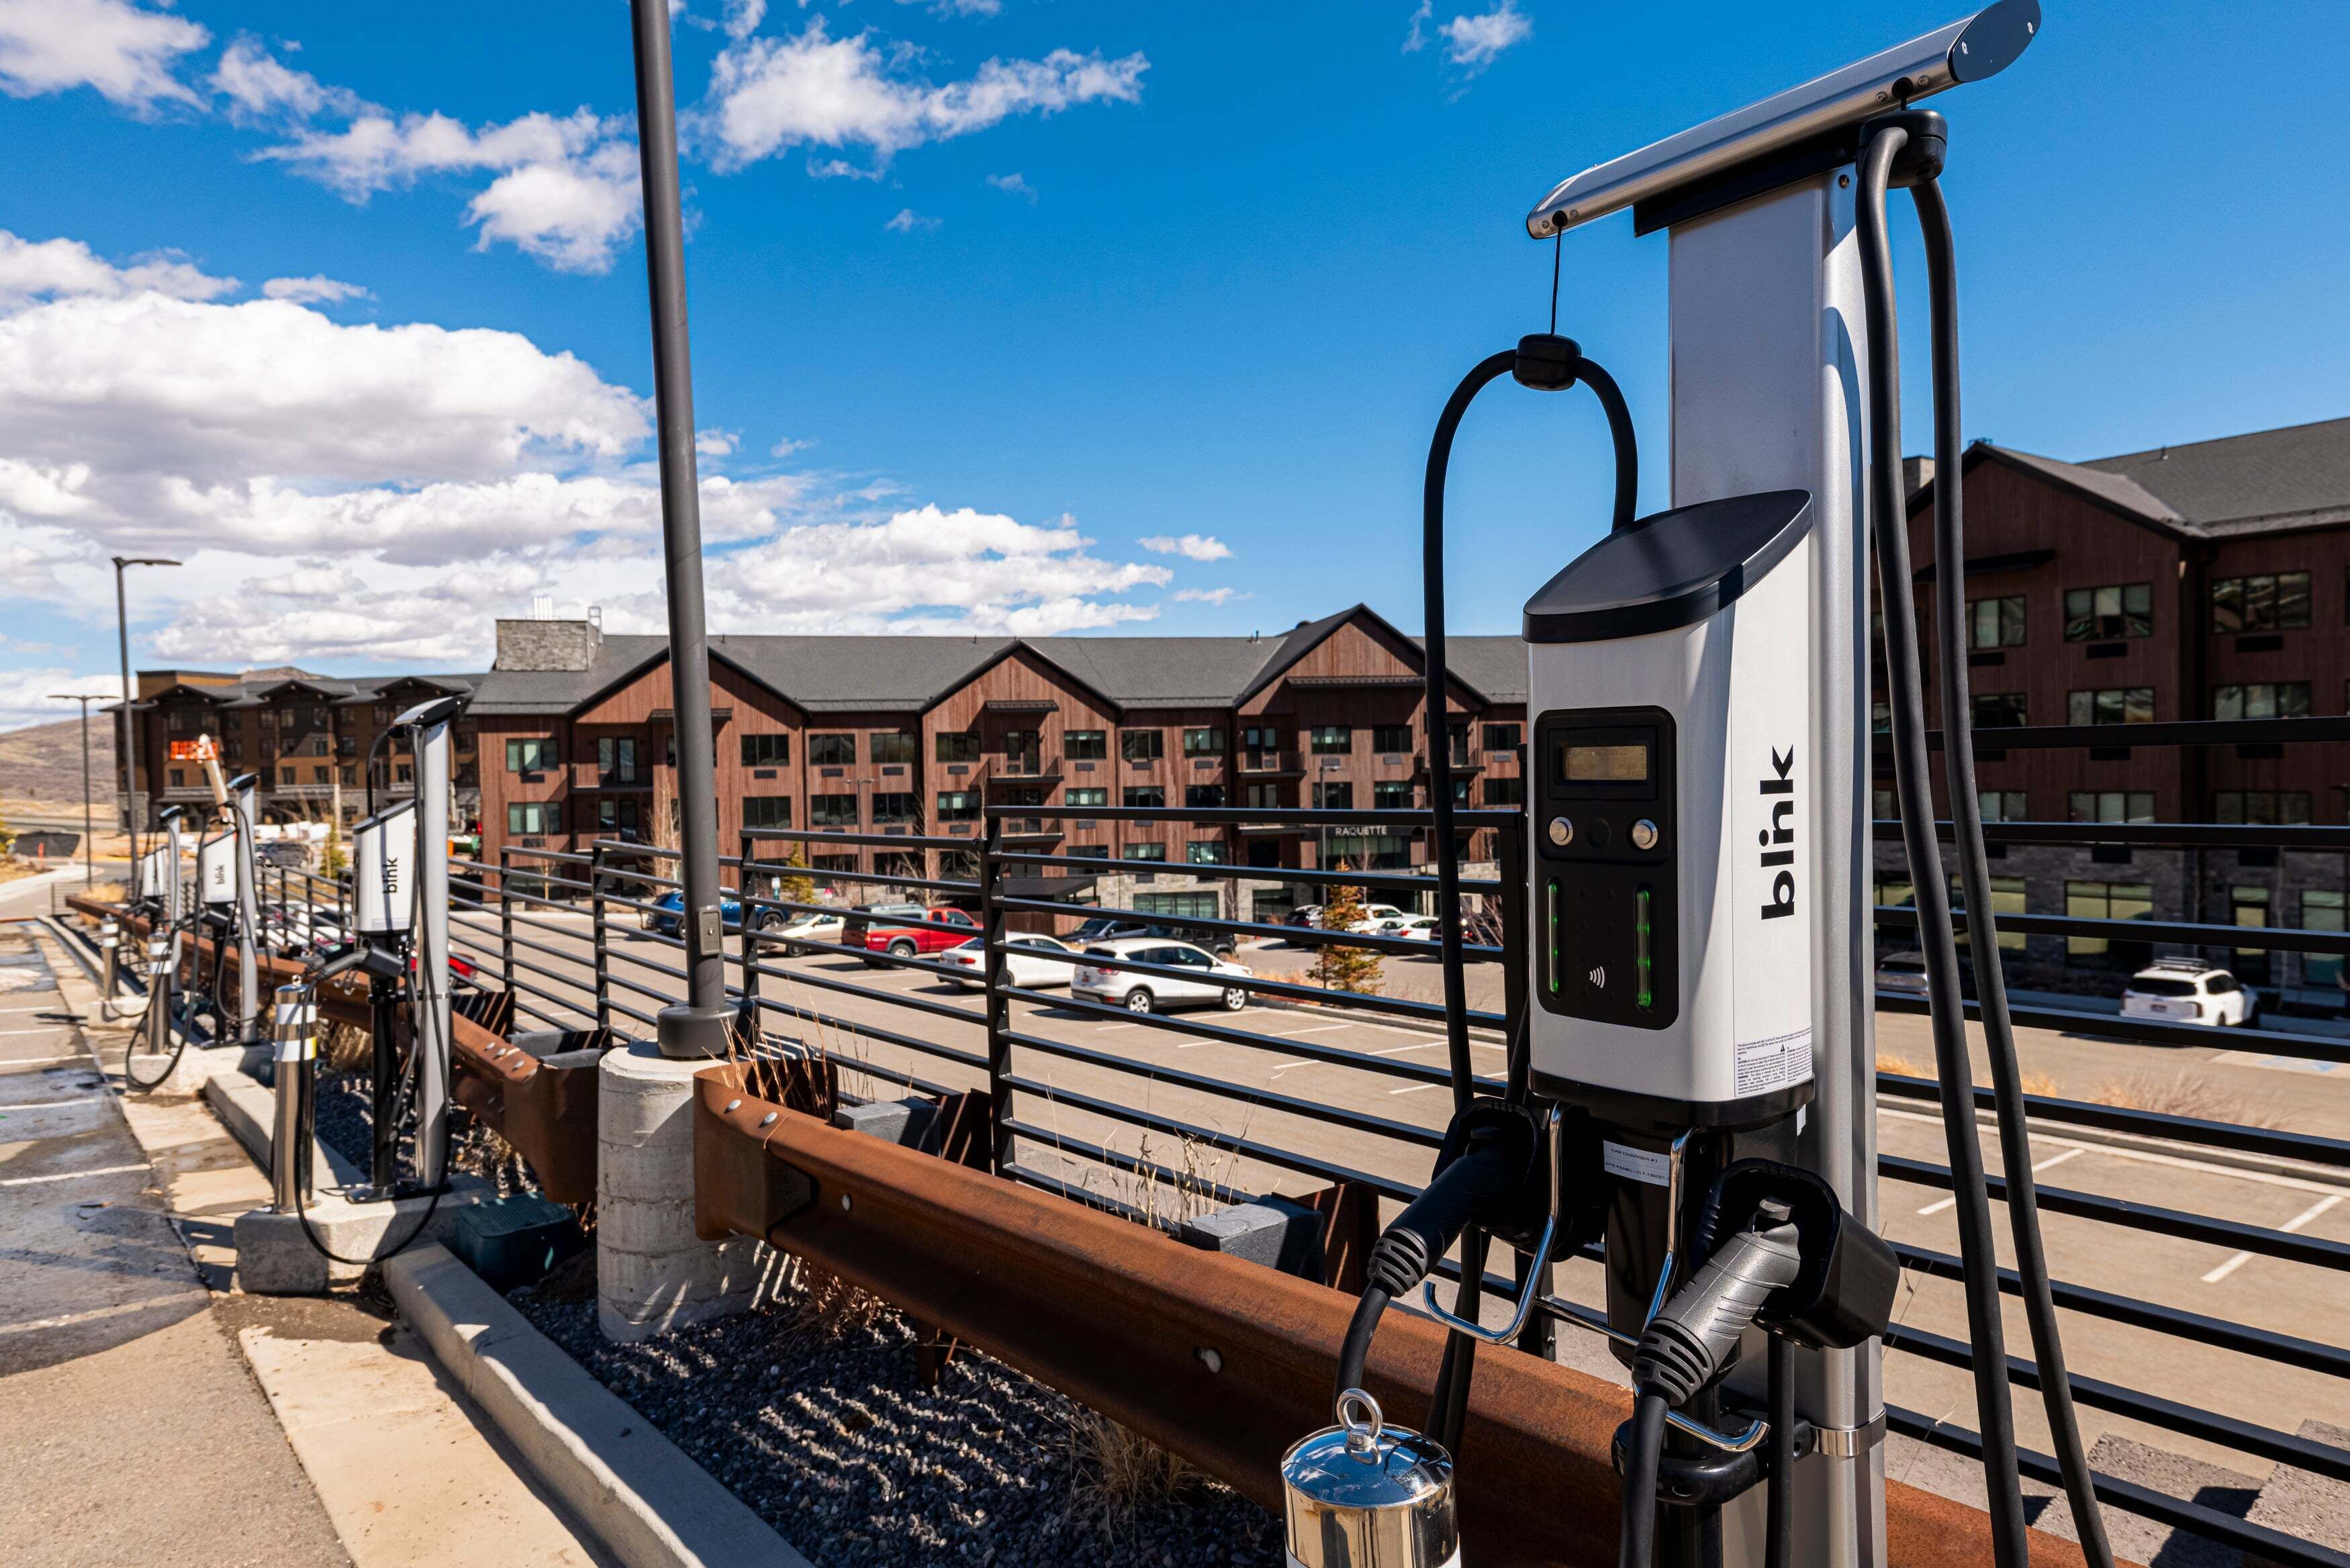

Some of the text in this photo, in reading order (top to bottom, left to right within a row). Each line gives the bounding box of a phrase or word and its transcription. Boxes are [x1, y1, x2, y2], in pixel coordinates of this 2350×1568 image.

[1335, 825, 1386, 836] RAQUETTE
[1758, 744, 1795, 920] blink
[215, 865, 226, 885] blink
[383, 857, 397, 893] blink
[1622, 1152, 1650, 1161] CHARGER
